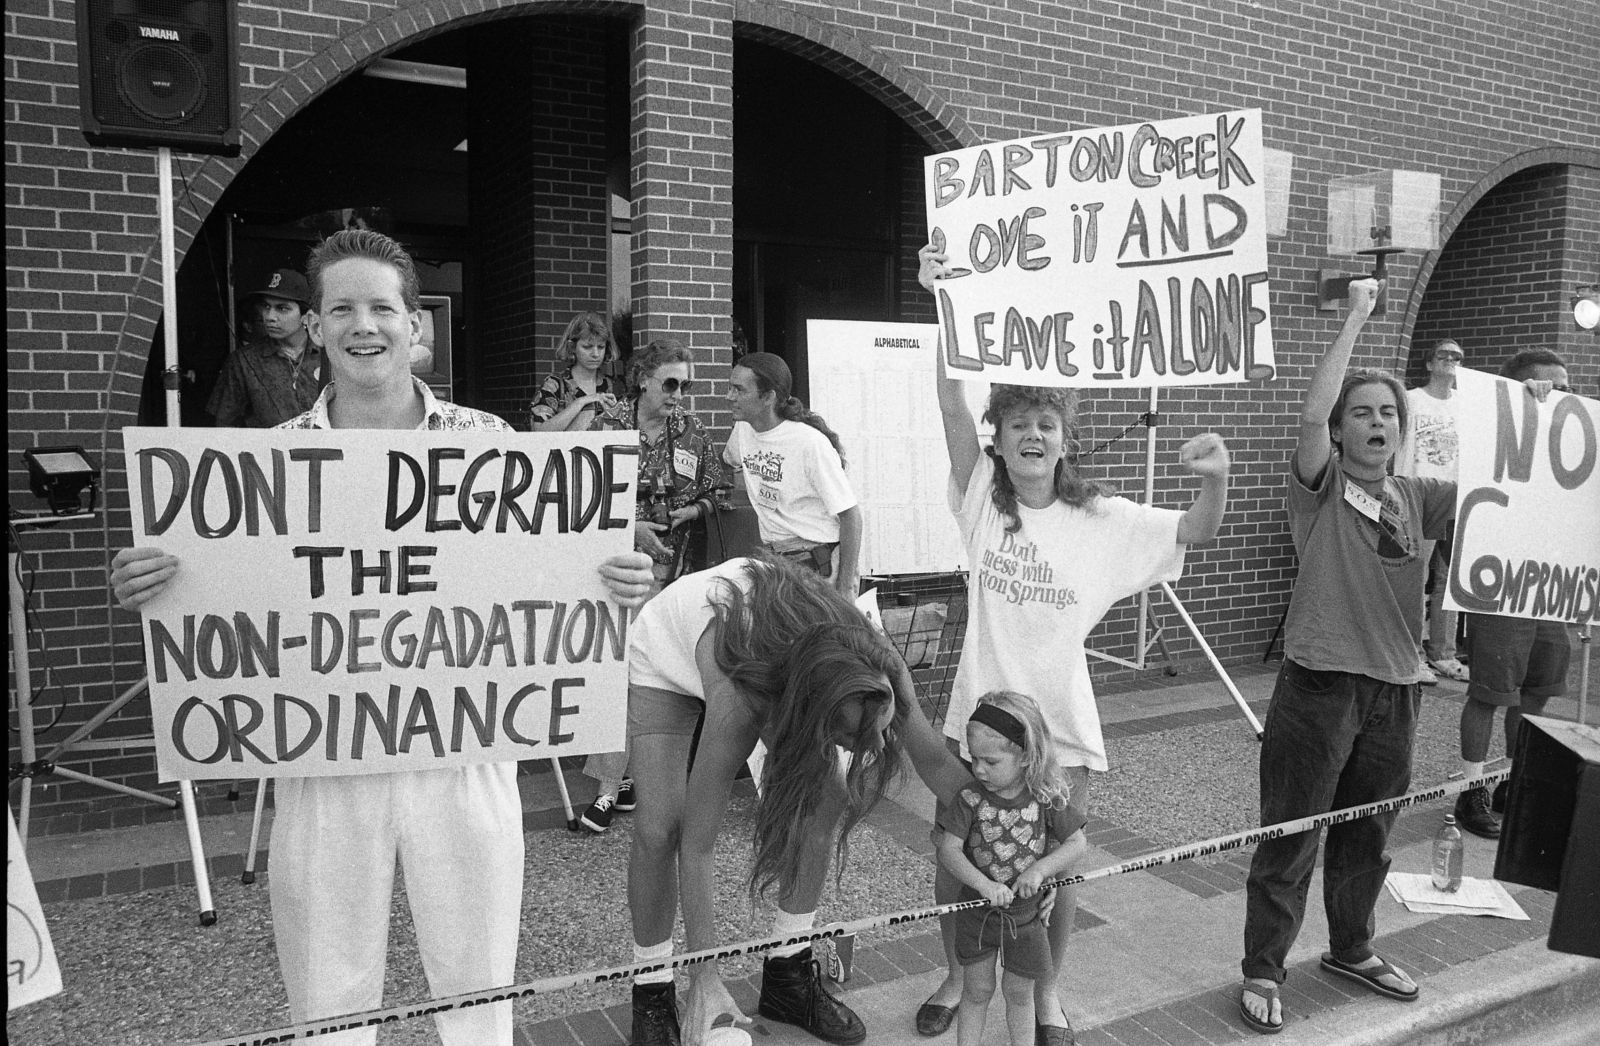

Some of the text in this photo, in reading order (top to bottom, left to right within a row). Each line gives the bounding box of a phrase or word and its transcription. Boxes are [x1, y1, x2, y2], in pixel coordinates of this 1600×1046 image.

[139, 26, 180, 41] YAMAHA
[935, 115, 1255, 208] BARTON CREEK
[1118, 194, 1248, 260] AND
[268, 273, 282, 288] B
[874, 337, 920, 349] ALPHABETICAL
[939, 288, 1079, 377] LEAVE
[1130, 271, 1275, 380] ALONE
[1493, 380, 1597, 490] NO
[137, 444, 639, 538] DONT DEGRADE
[294, 546, 438, 598] THE
[982, 549, 1053, 584] mess with
[999, 532, 1038, 562] Don't
[1007, 580, 1077, 610] Springs.
[150, 599, 628, 682] NON-DEGADATION
[172, 677, 586, 764] ORDINANCE
